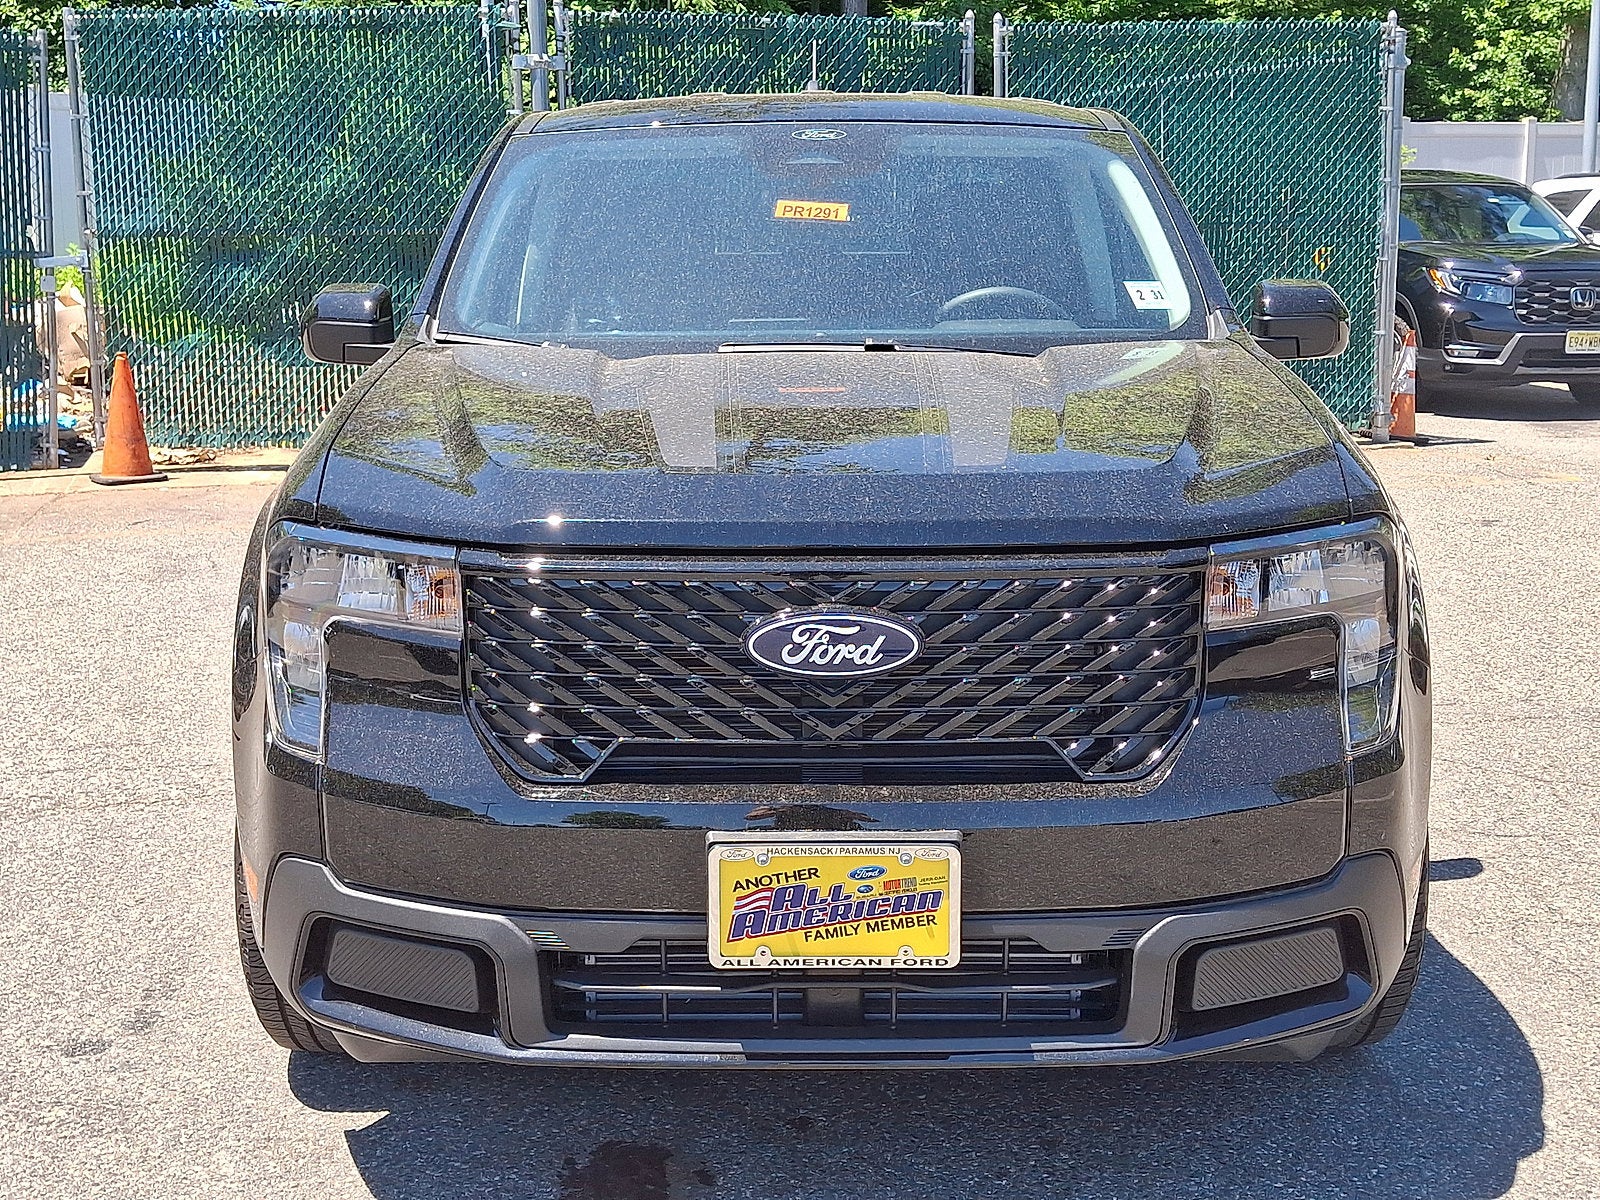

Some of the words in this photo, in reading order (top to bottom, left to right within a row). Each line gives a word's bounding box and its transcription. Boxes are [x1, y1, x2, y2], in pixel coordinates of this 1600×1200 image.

[801, 129, 838, 139] Ford
[782, 205, 840, 219] PR1291
[1136, 289, 1146, 300] 2
[1151, 289, 1165, 300] 31
[781, 623, 887, 665] Ford
[888, 847, 901, 855] NJ
[732, 867, 821, 892] ANOTHER
[854, 867, 880, 879] Ford
[770, 882, 855, 913] ALL
[803, 923, 861, 943] FAMILY
[866, 914, 938, 934] MEMBER
[721, 959, 760, 967] ALL
[767, 958, 883, 967] AMERICAN
[890, 958, 949, 967] FORD
